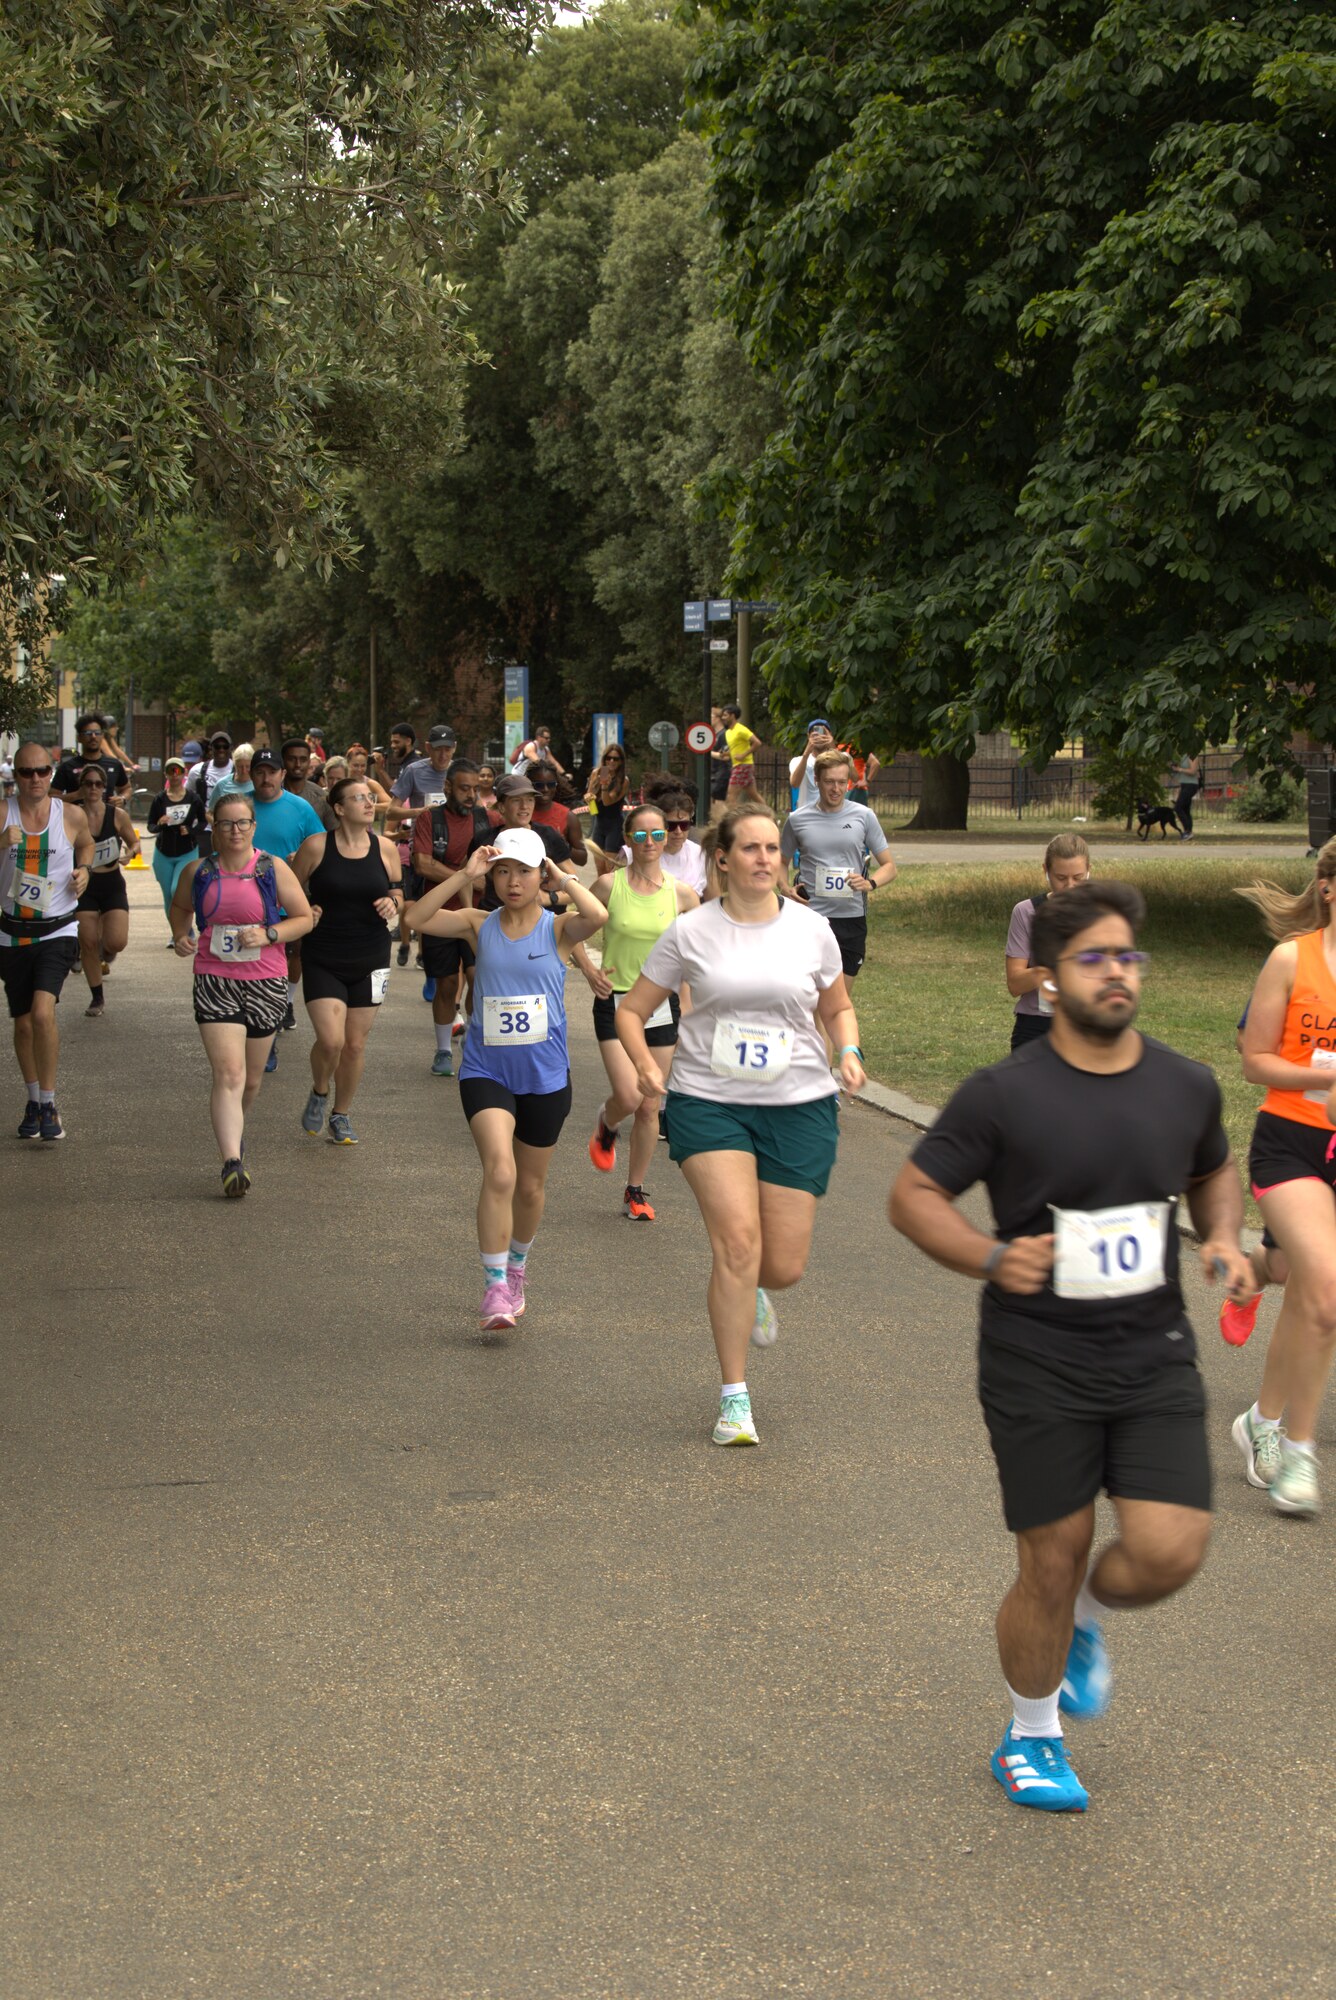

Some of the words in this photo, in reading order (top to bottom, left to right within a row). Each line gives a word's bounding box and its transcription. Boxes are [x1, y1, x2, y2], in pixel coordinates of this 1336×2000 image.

[696, 731, 706, 744] 5
[173, 810, 185, 821] 32
[95, 847, 111, 860] 77
[825, 876, 844, 890] 50
[18, 882, 41, 901] 79
[499, 1011, 531, 1034] 38
[735, 1041, 769, 1069] 13
[1088, 1234, 1141, 1277] 10
